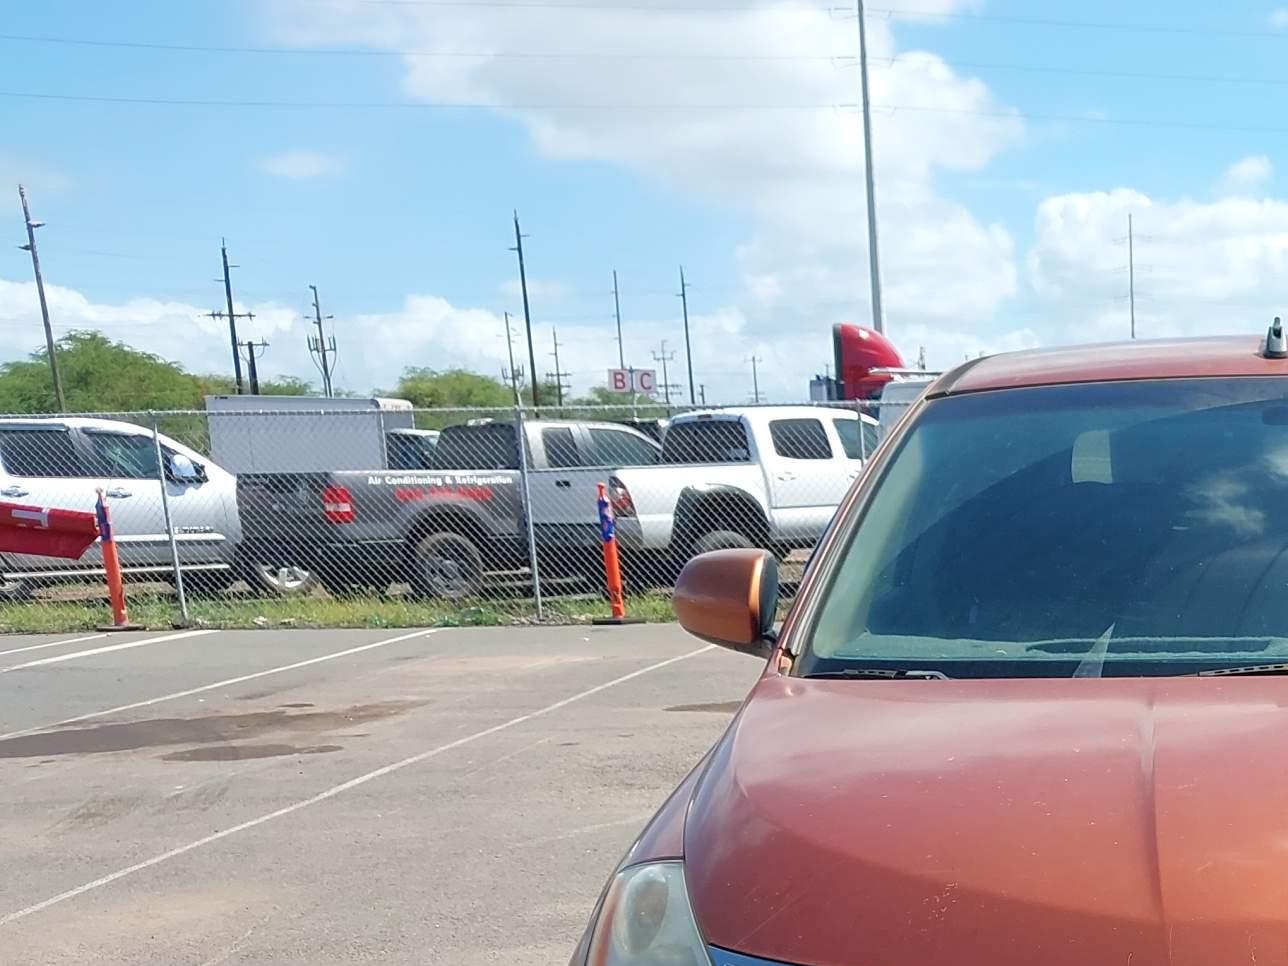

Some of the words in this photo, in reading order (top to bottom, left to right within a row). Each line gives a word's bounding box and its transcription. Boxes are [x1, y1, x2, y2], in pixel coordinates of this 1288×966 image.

[613, 372, 626, 390] B
[640, 372, 652, 390] C
[368, 476, 382, 485] Air
[385, 475, 443, 487] Conditioning
